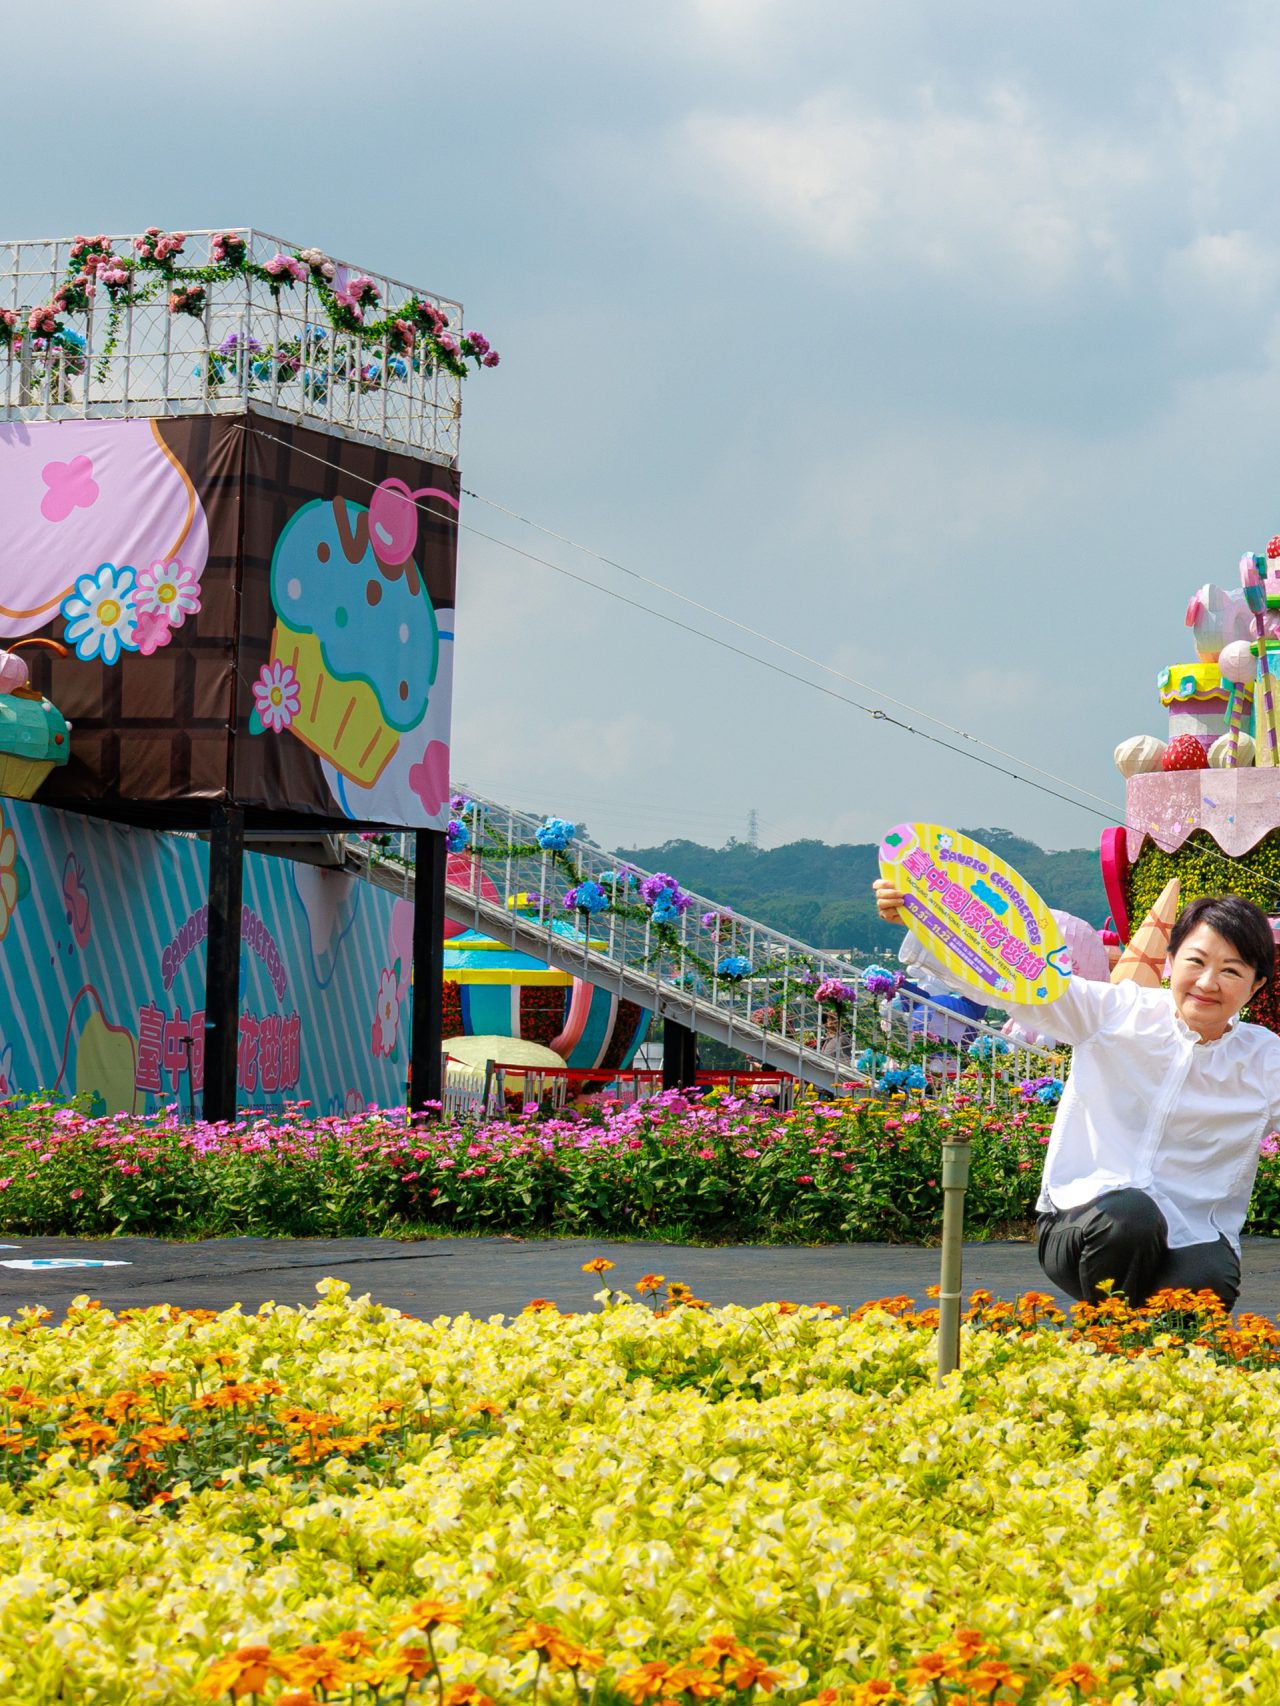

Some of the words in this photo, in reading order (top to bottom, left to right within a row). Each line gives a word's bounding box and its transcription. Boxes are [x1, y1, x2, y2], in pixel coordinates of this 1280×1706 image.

[939, 848, 988, 874] SANRIO
[990, 872, 1041, 945] CHARACTERS
[242, 904, 287, 1001] RACTERS
